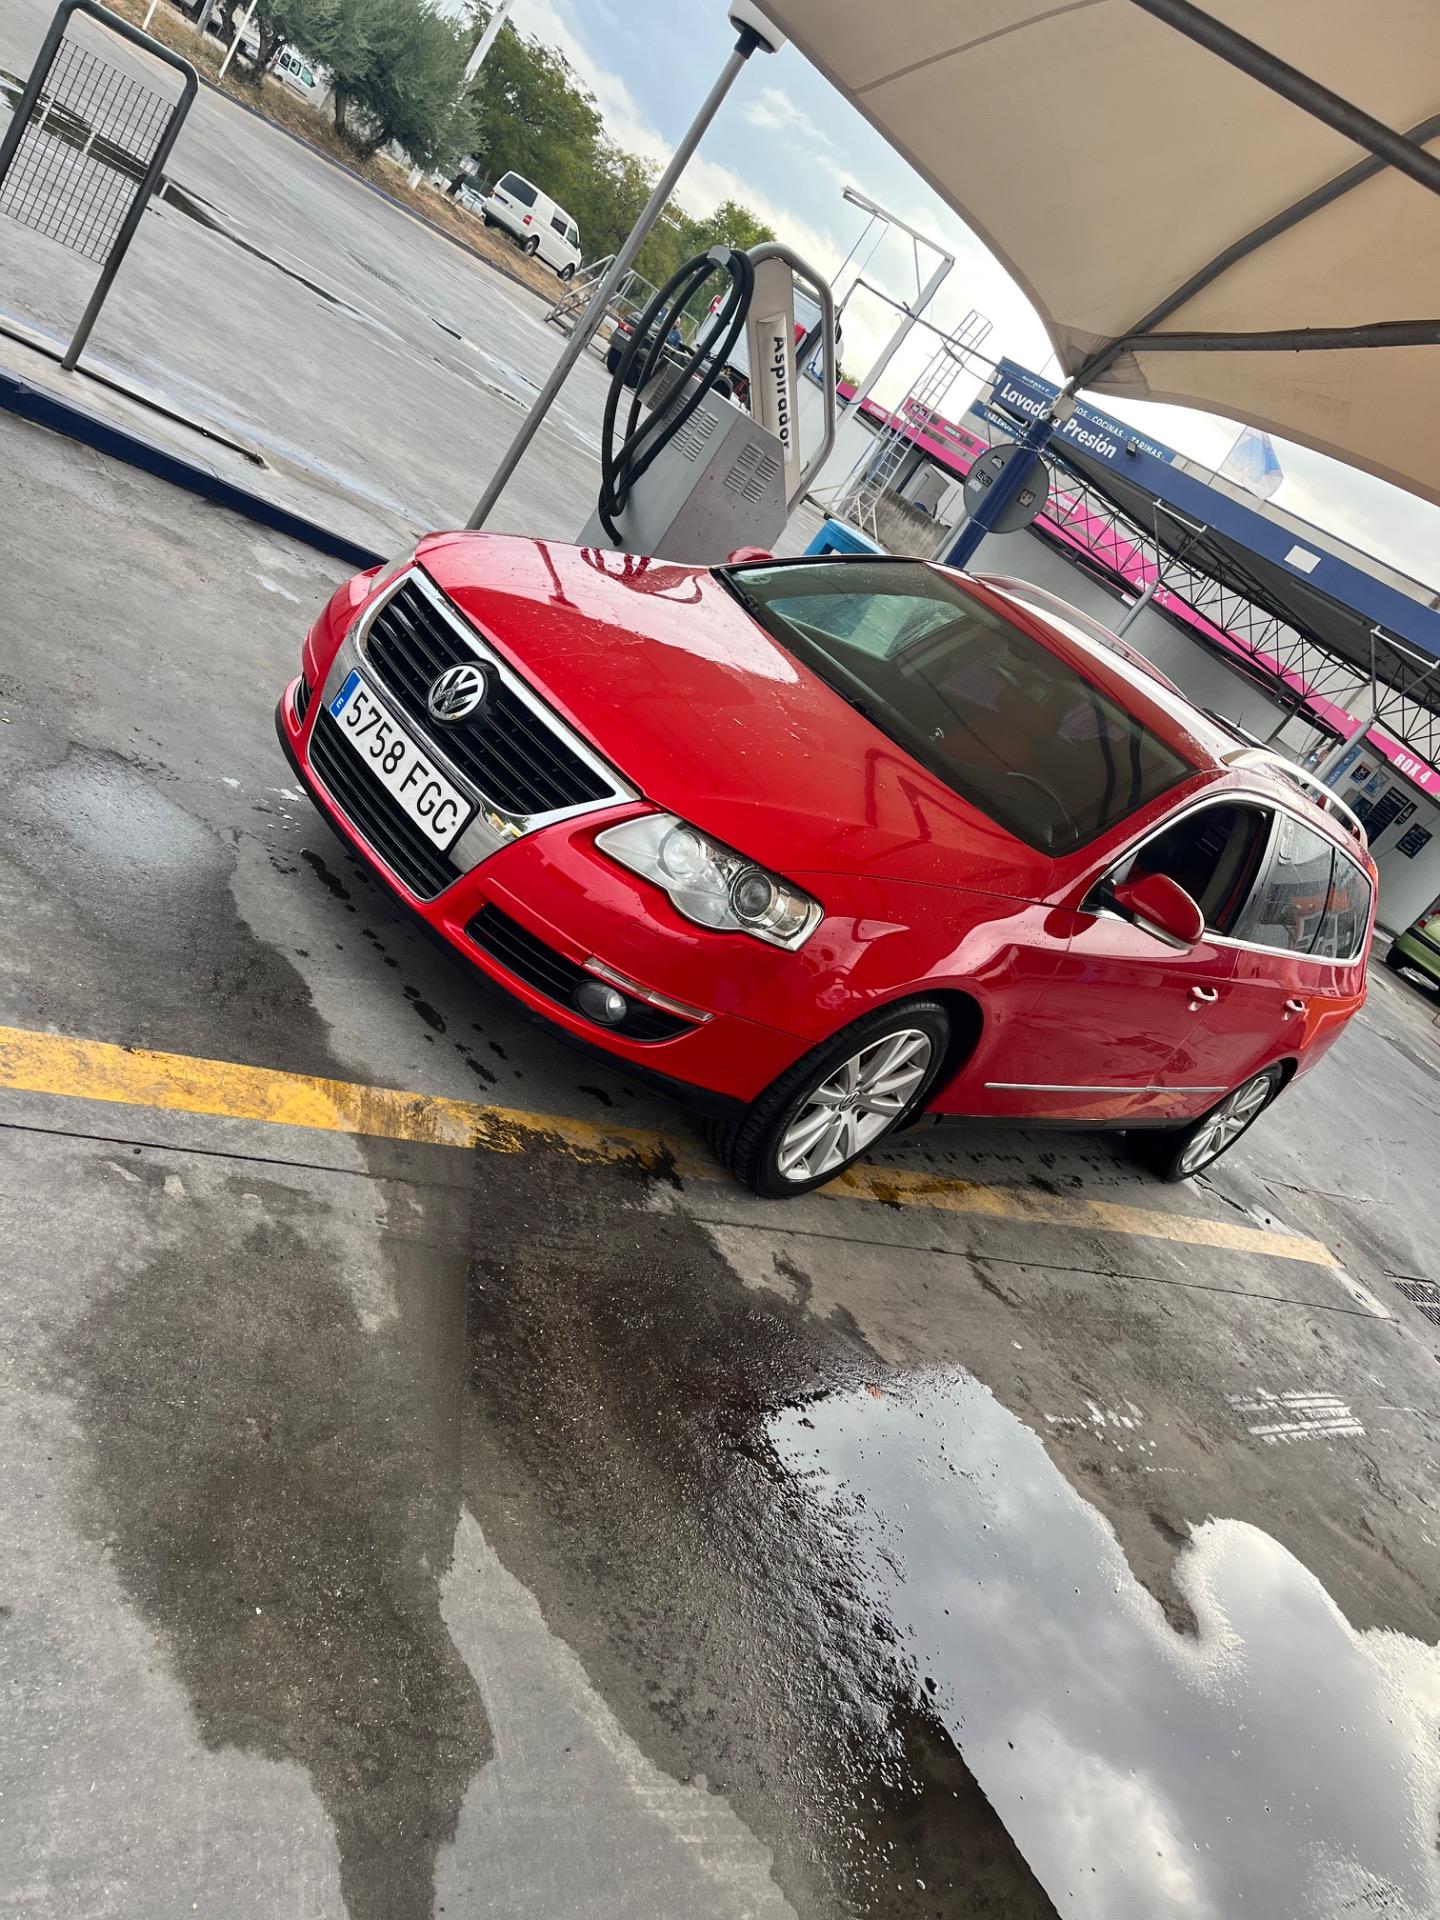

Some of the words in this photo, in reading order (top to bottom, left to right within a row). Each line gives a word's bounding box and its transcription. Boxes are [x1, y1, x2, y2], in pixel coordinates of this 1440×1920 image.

[769, 336, 791, 449] Aspirador
[1000, 382, 1051, 420] Lavado
[1062, 417, 1117, 459] Presión
[1091, 415, 1124, 438] COCINAS
[346, 691, 406, 775] 5758
[399, 760, 458, 834] FGC
[1393, 753, 1421, 777] BOX
[1419, 770, 1432, 784] 4
